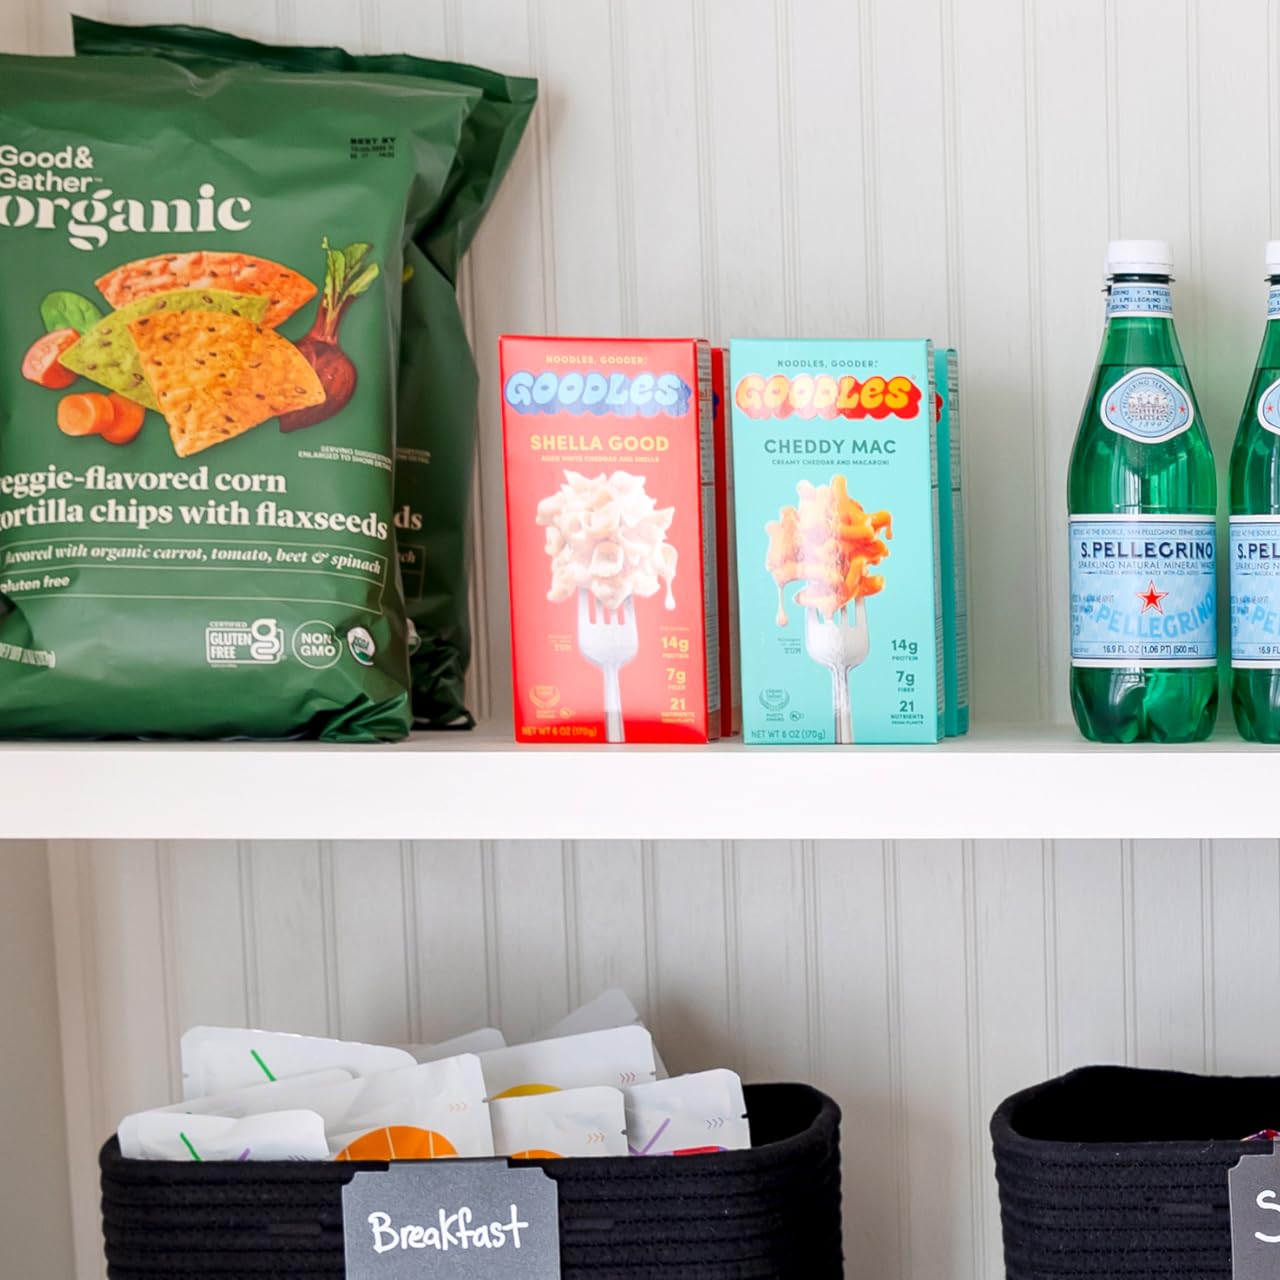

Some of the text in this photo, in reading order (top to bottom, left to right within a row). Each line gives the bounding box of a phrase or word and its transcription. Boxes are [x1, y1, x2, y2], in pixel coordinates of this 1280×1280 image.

[0, 145, 93, 169] Good&
[0, 183, 252, 251] organic
[777, 359, 828, 369] NOODLES,
[505, 370, 692, 418] GOODLES
[735, 374, 923, 420] GOODLES
[530, 435, 670, 451] SHELLA GOOD
[764, 439, 897, 455] CHEDDY MAC
[0, 464, 287, 499] eggie-flavored corn
[90, 498, 173, 529] chips
[180, 501, 250, 526] with
[256, 501, 388, 540] flaxseeds
[1081, 541, 1213, 559] S.PELLEGRINO
[56, 544, 87, 559] with
[91, 545, 150, 562] organic
[153, 548, 207, 562] carrot,
[211, 549, 272, 564] tomato,
[276, 549, 307, 563] beet
[311, 551, 330, 564] &
[331, 554, 381, 575] spinach
[1118, 561, 1160, 569] NATURAL
[1164, 561, 1198, 569] MINERAL
[43, 575, 70, 589] free
[210, 632, 251, 646] GLUTEN
[301, 632, 333, 645] NON
[661, 636, 689, 653] 14g
[210, 646, 236, 659] FREE
[301, 644, 336, 657] GMO
[891, 639, 919, 655] 14g
[1103, 645, 1116, 654] 16.9
[1118, 645, 1126, 654] FL
[1128, 645, 1140, 654] OZ
[1258, 646, 1271, 655] 16.9
[1273, 646, 1280, 655] FL
[666, 667, 686, 684] 7g
[895, 670, 916, 686] 7g
[670, 697, 686, 711] 21
[899, 700, 915, 712] 21
[751, 729, 766, 739] NET
[767, 729, 780, 739] WT
[788, 729, 801, 739] OZ
[368, 1205, 529, 1255] Breakfast
